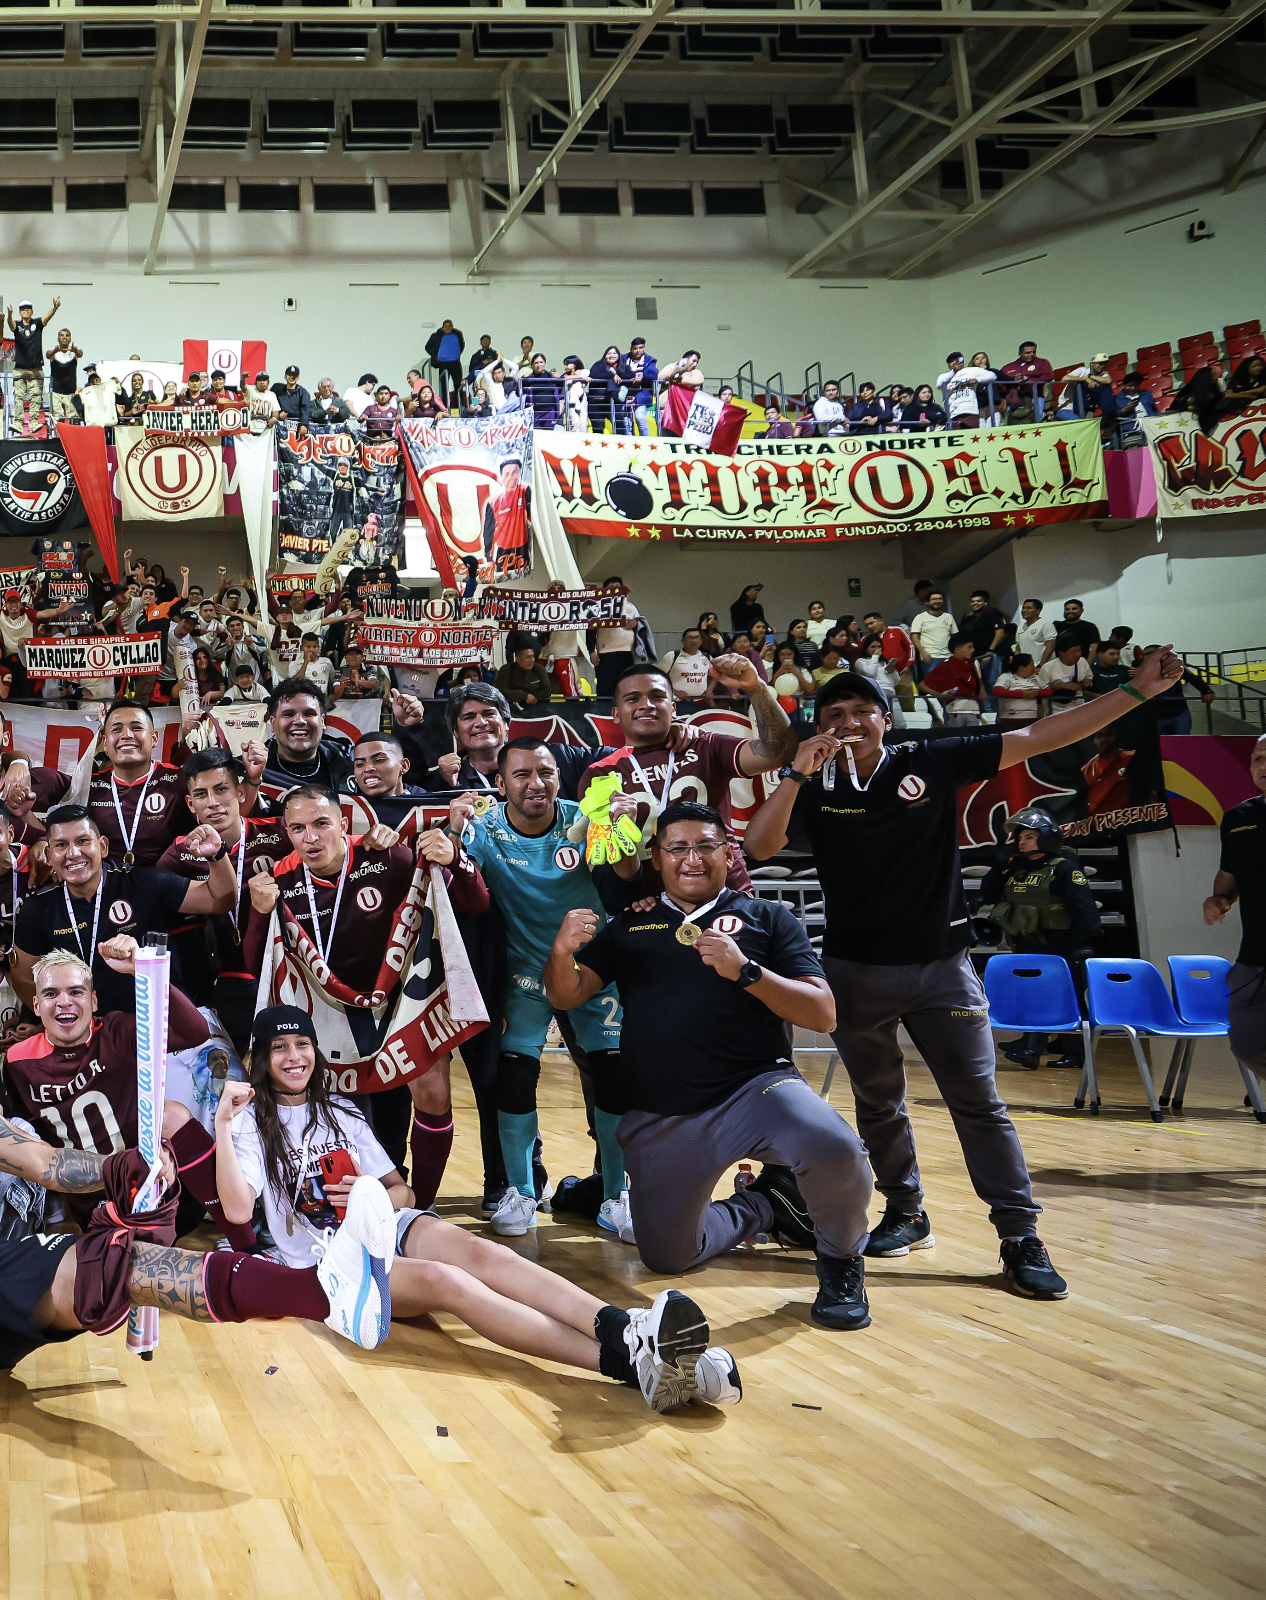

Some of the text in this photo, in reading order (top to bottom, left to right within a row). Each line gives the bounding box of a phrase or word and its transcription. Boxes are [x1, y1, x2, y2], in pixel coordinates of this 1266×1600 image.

[146, 407, 249, 431] JAVIER HERAUD
[131, 435, 208, 460] POLIDEPORTIVO
[663, 435, 965, 457] TRCHERA NORTE
[3, 453, 69, 476] UNIVERSITARIO
[4, 493, 69, 520] ANTIFASCISTA
[673, 528, 690, 538] LA
[693, 528, 747, 540] CURVA
[835, 524, 913, 537] FUNDADO:
[915, 516, 991, 531] 28-04-1998
[48, 583, 88, 598] NOVENO
[440, 629, 491, 645] NORTE
[549, 622, 588, 631] PELIGROSO
[89, 636, 125, 644] SIEMPRE
[422, 648, 440, 657] LOS
[443, 646, 478, 657] OLIVOS
[28, 647, 85, 669] MARQUEZ
[1095, 803, 1168, 832] PRESENTE
[386, 867, 431, 972] OESTE
[629, 921, 669, 933] marathon
[277, 1023, 300, 1031] POLO
[375, 1038, 417, 1084] DE
[29, 1058, 106, 1103] LETTO R.
[39, 1090, 126, 1157] 10
